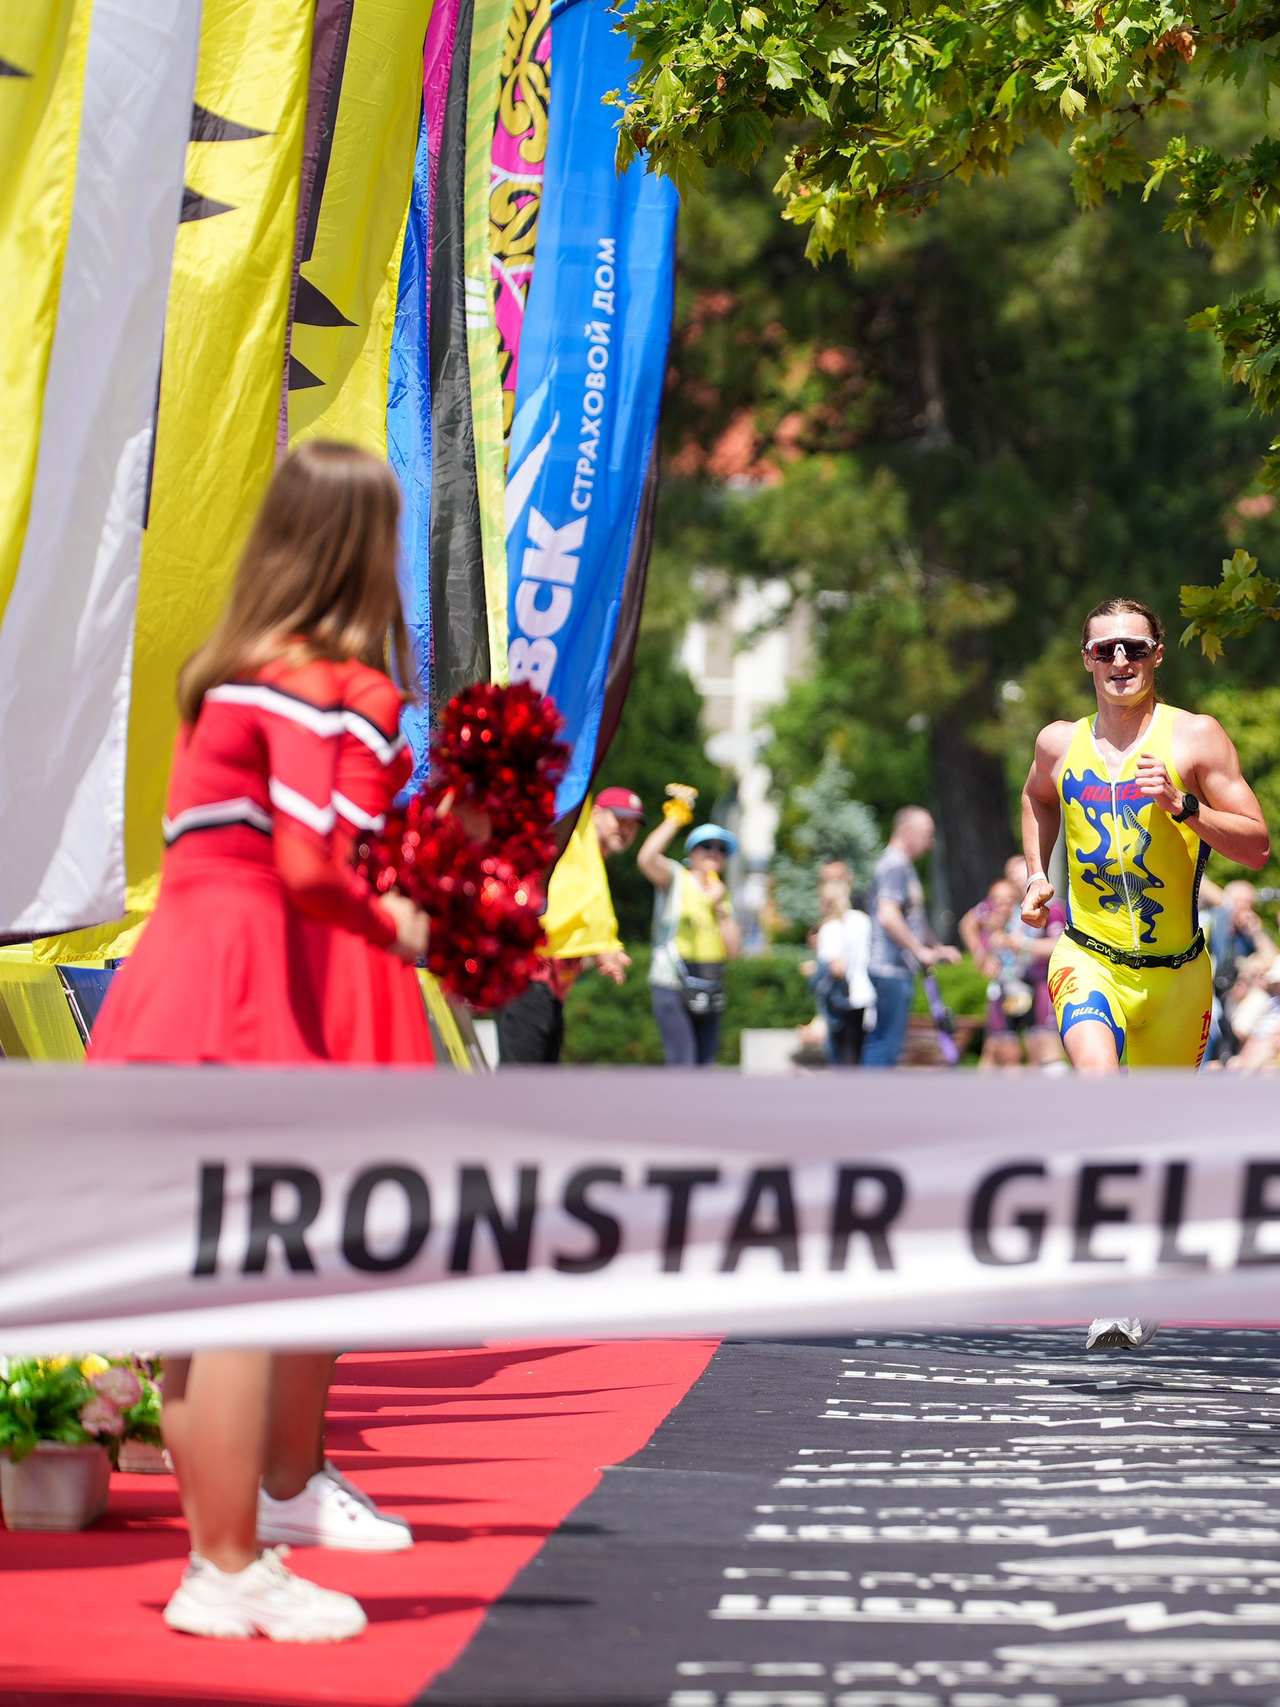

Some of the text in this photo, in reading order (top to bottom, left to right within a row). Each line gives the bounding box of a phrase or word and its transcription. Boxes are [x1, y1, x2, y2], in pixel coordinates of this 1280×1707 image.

[570, 237, 616, 512] СТРАХОВОЙ ДОМ
[509, 505, 588, 699] ВСК
[192, 1160, 908, 1276] IRONSTAR
